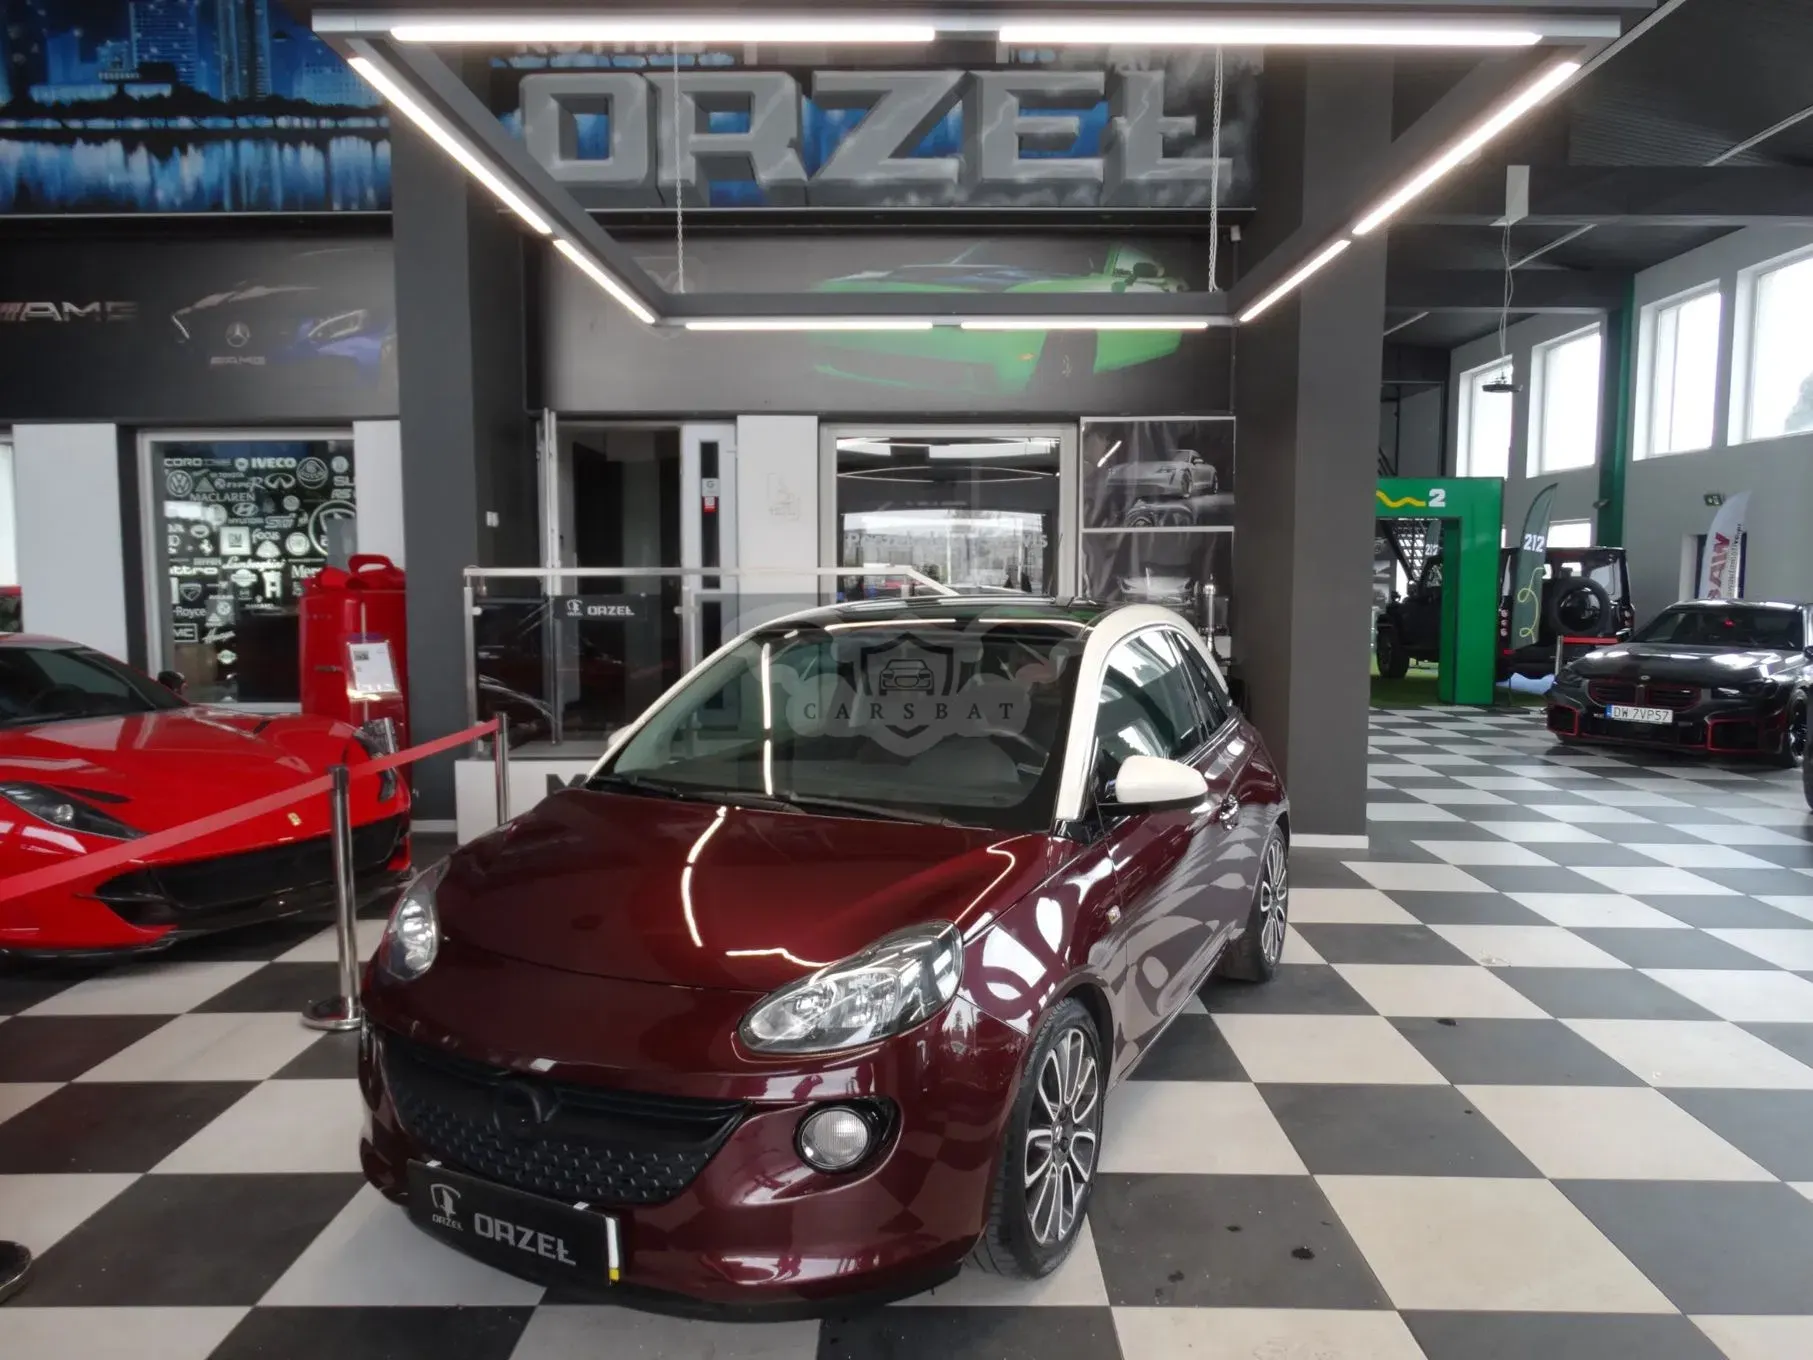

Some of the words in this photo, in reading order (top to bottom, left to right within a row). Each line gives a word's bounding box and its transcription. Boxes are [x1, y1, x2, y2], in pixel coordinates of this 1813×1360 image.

[518, 70, 1233, 184] ORZEŁ
[251, 457, 298, 469] IVECO
[190, 492, 256, 502] MACLAREN
[1523, 533, 1546, 553] 212
[587, 605, 636, 616] ORZEŁ
[1613, 706, 1629, 718] DW
[1632, 708, 1670, 721] 7VP57
[473, 1212, 577, 1266] ORZEŁ
